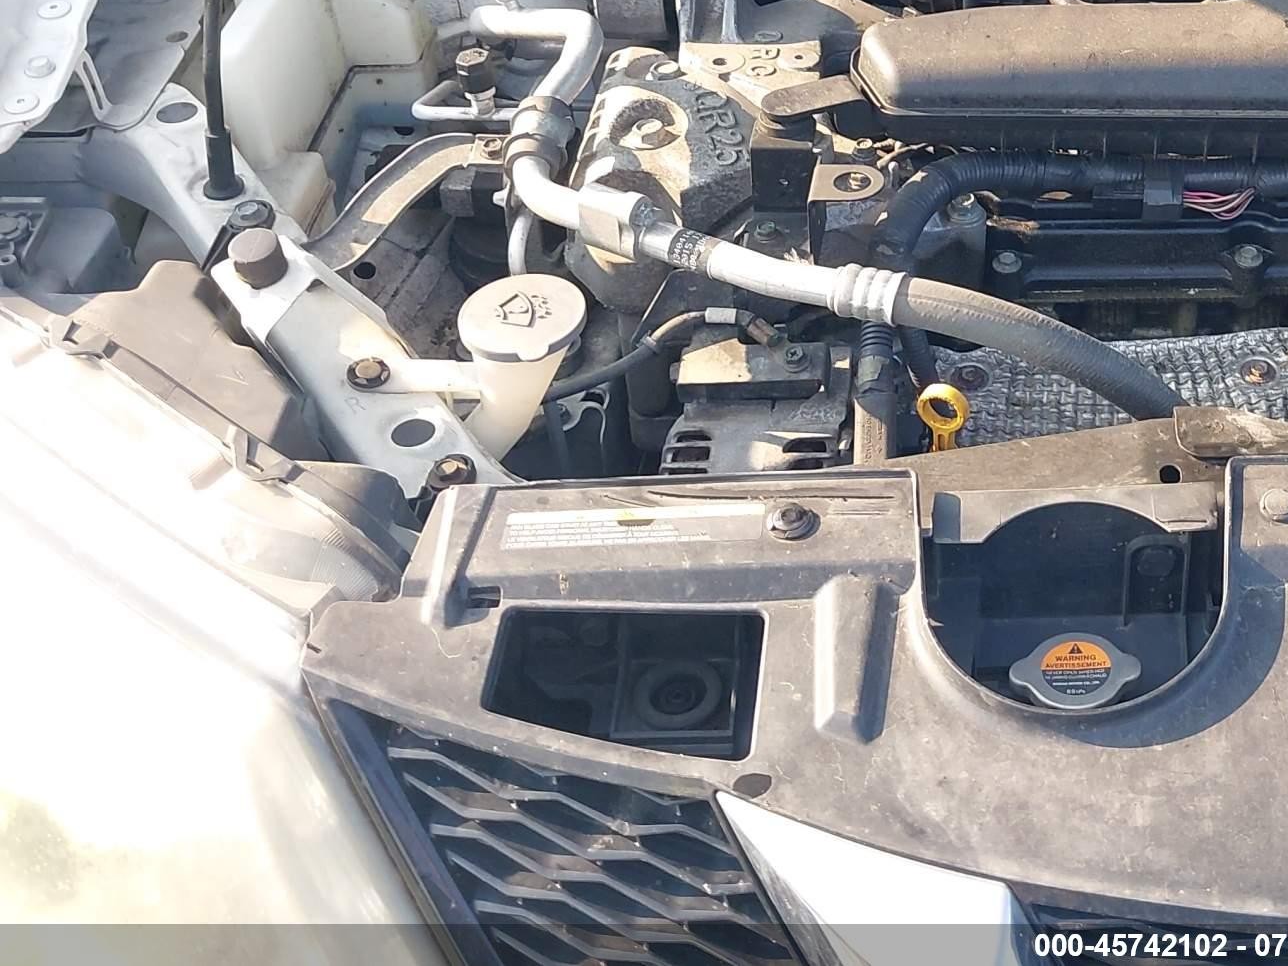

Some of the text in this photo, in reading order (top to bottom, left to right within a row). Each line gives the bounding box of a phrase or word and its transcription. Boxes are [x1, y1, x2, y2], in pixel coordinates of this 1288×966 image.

[694, 90, 752, 166] QR25
[1055, 654, 1096, 662] WARNING
[1045, 661, 1107, 669] AVERTISSEMENT
